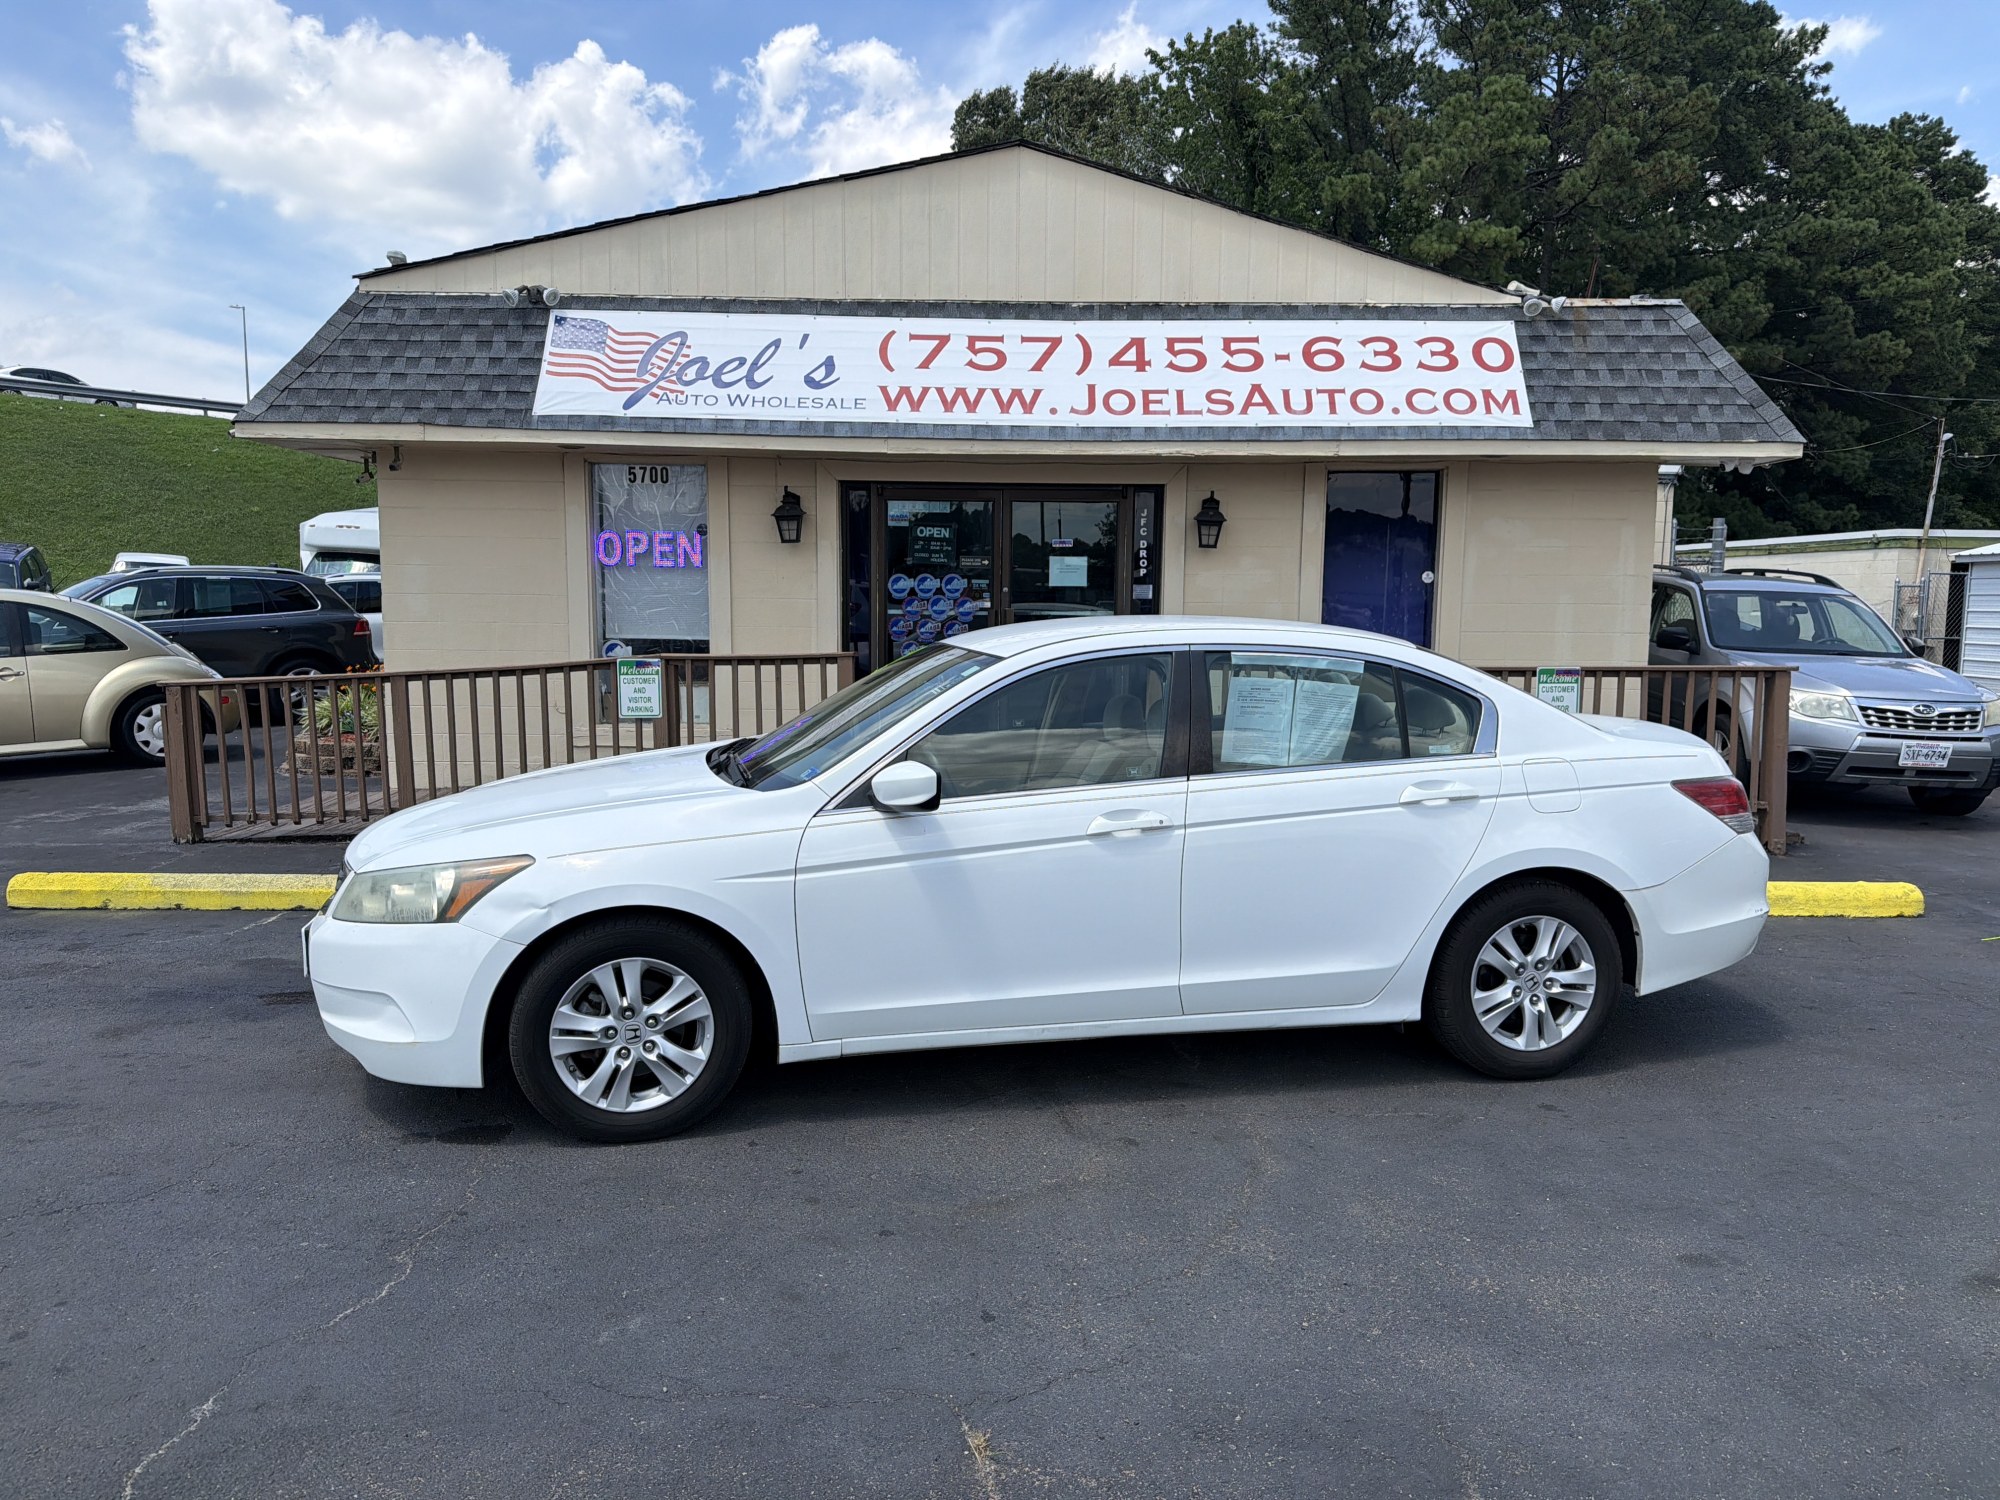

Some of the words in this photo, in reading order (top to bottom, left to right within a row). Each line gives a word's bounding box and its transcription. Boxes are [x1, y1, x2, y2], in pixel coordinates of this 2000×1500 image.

[878, 329, 1515, 376] (757)455-6330
[622, 330, 840, 411] Joel's
[656, 391, 719, 406] AUTO
[727, 393, 867, 410] WHOLESALE
[877, 383, 1522, 416] WWW.JOELSAUTO.COM
[628, 466, 669, 484] 5700
[1140, 508, 1148, 536] JFC
[916, 526, 950, 538] OPEN
[596, 529, 703, 568] OPEN
[1139, 540, 1148, 577] DROP
[620, 665, 659, 675] Welcome
[622, 677, 657, 685] CUSTOMER
[1540, 674, 1577, 683] Welcome
[1541, 685, 1576, 693] CUSTOMER
[627, 696, 652, 704] VISITOR
[1551, 695, 1565, 703] AND
[626, 705, 654, 713] PARKING
[1904, 749, 1948, 761] SXF-6734
